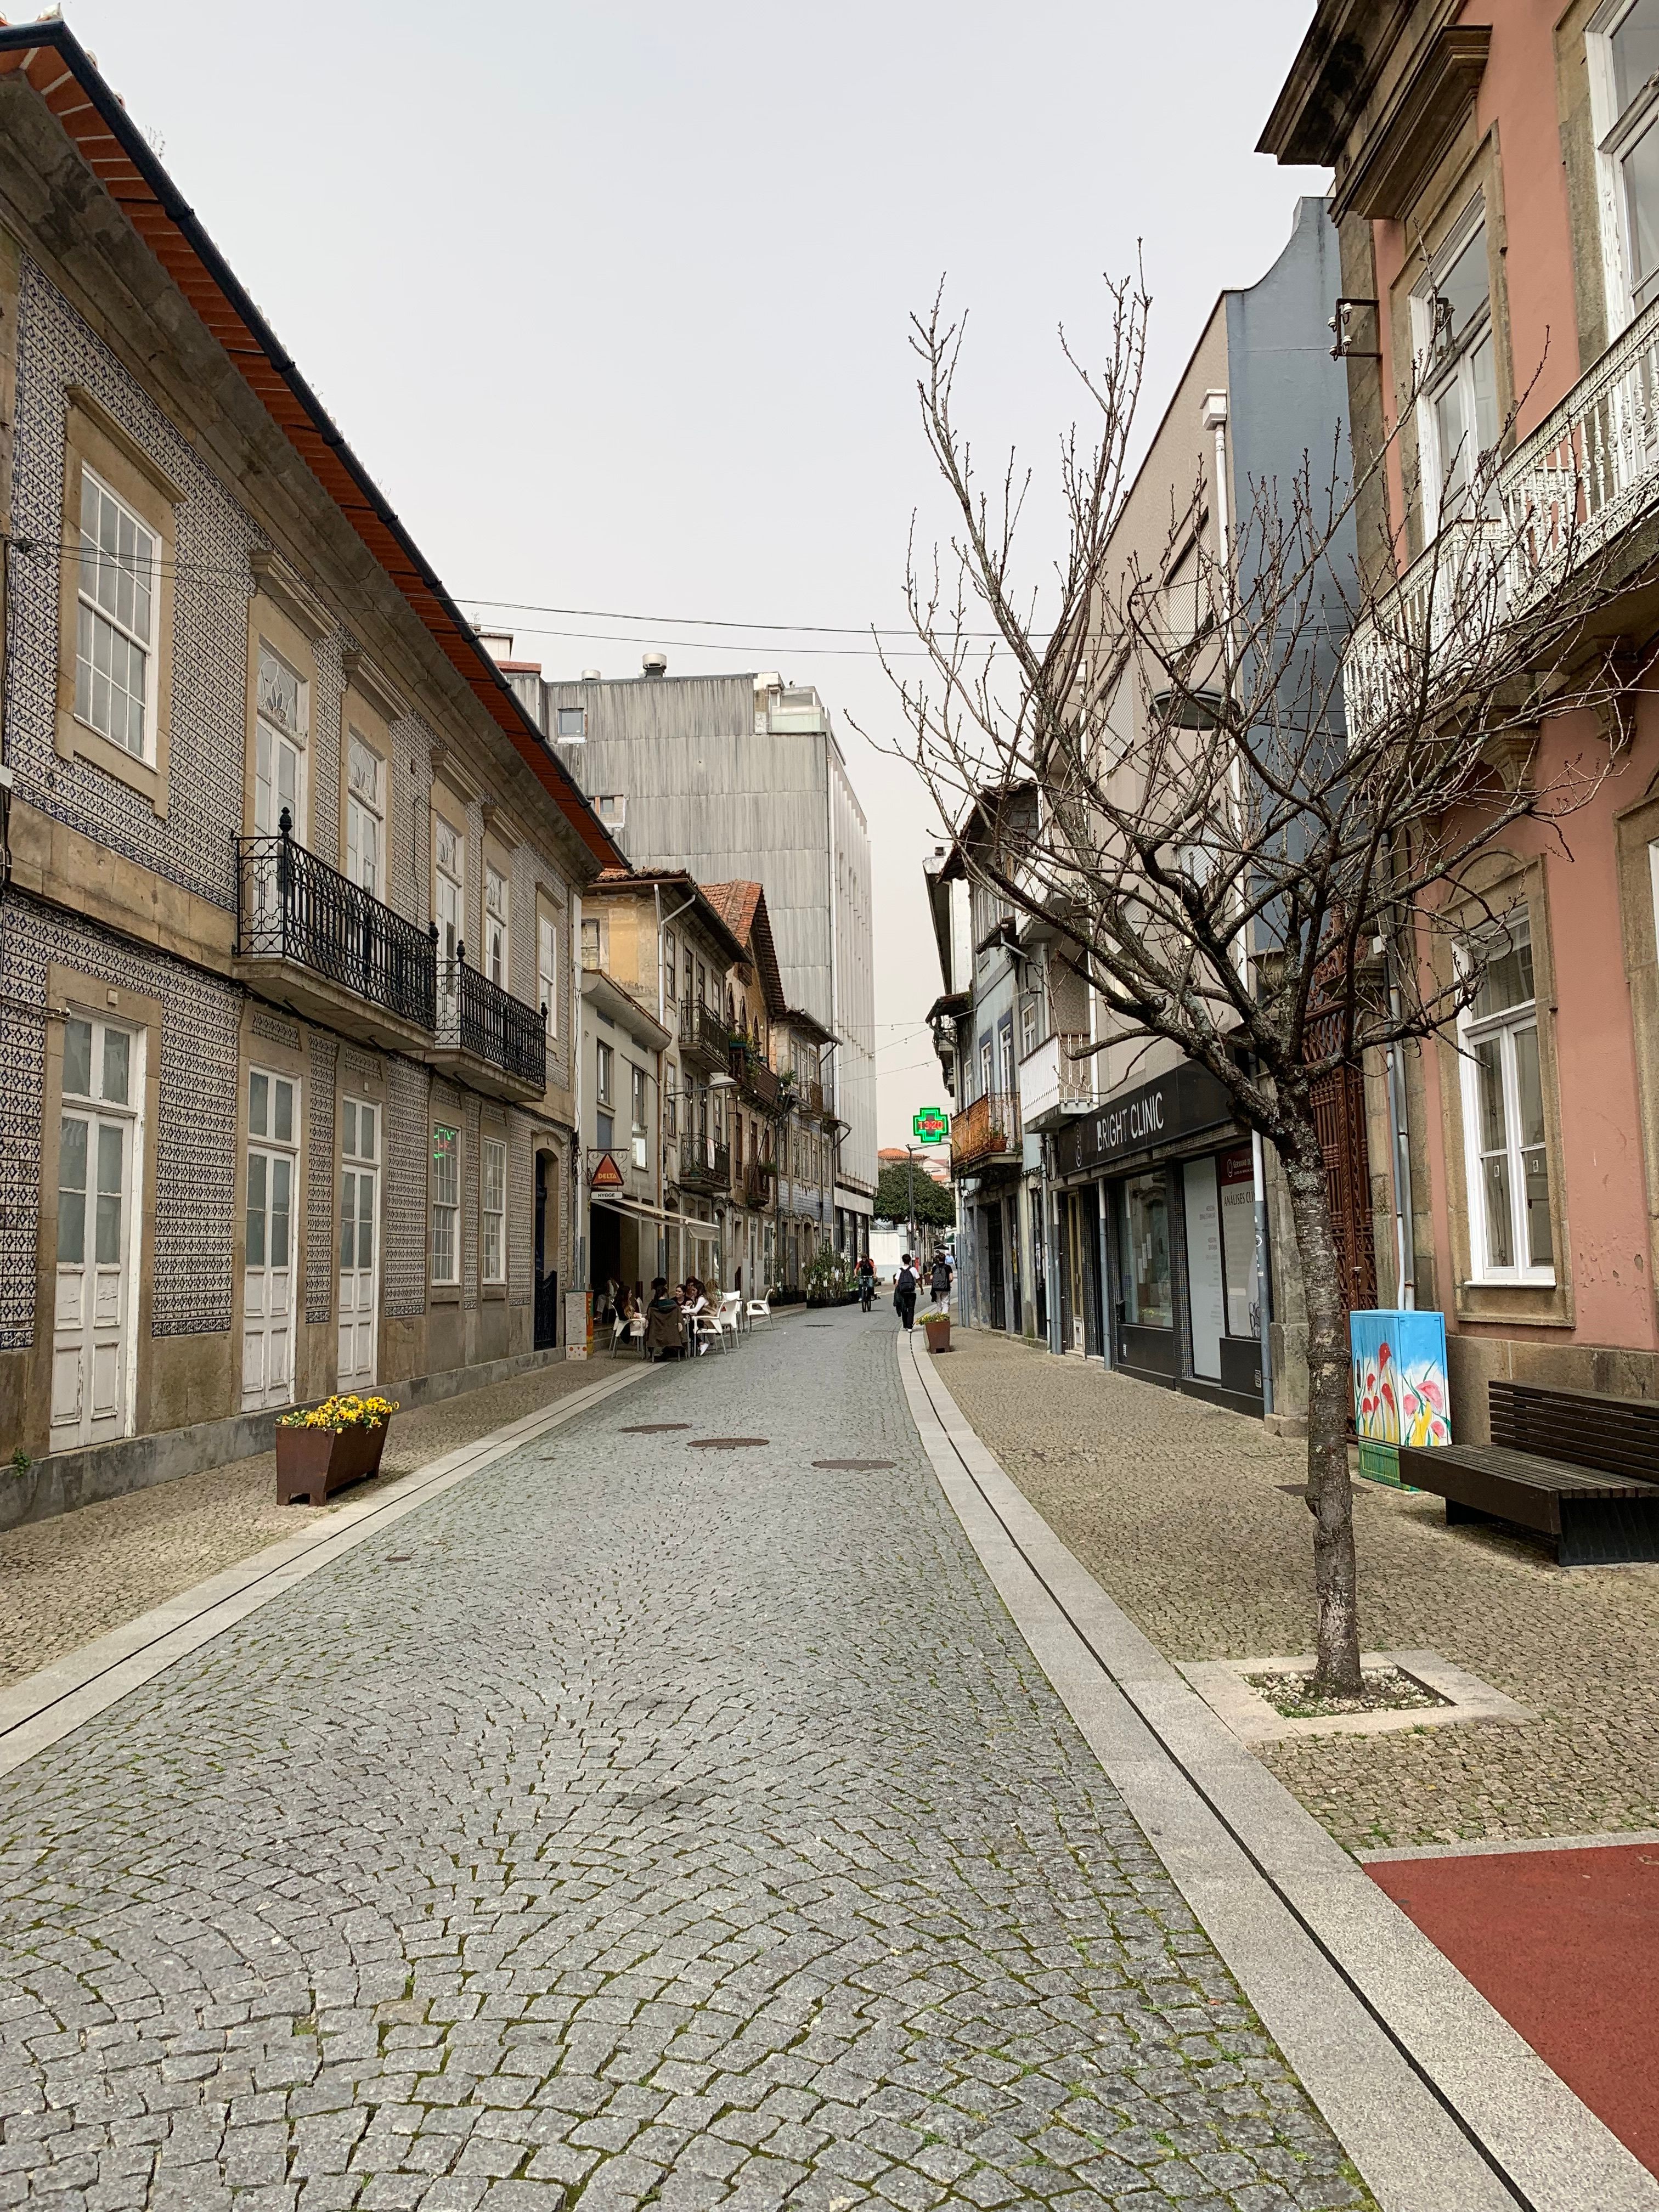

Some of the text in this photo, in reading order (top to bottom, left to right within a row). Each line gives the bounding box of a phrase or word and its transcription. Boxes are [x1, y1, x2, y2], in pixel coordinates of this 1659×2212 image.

[1097, 1092, 1164, 1152] BRIGHT CLINIC
[1224, 1192, 1245, 1206] ANÁLISES
